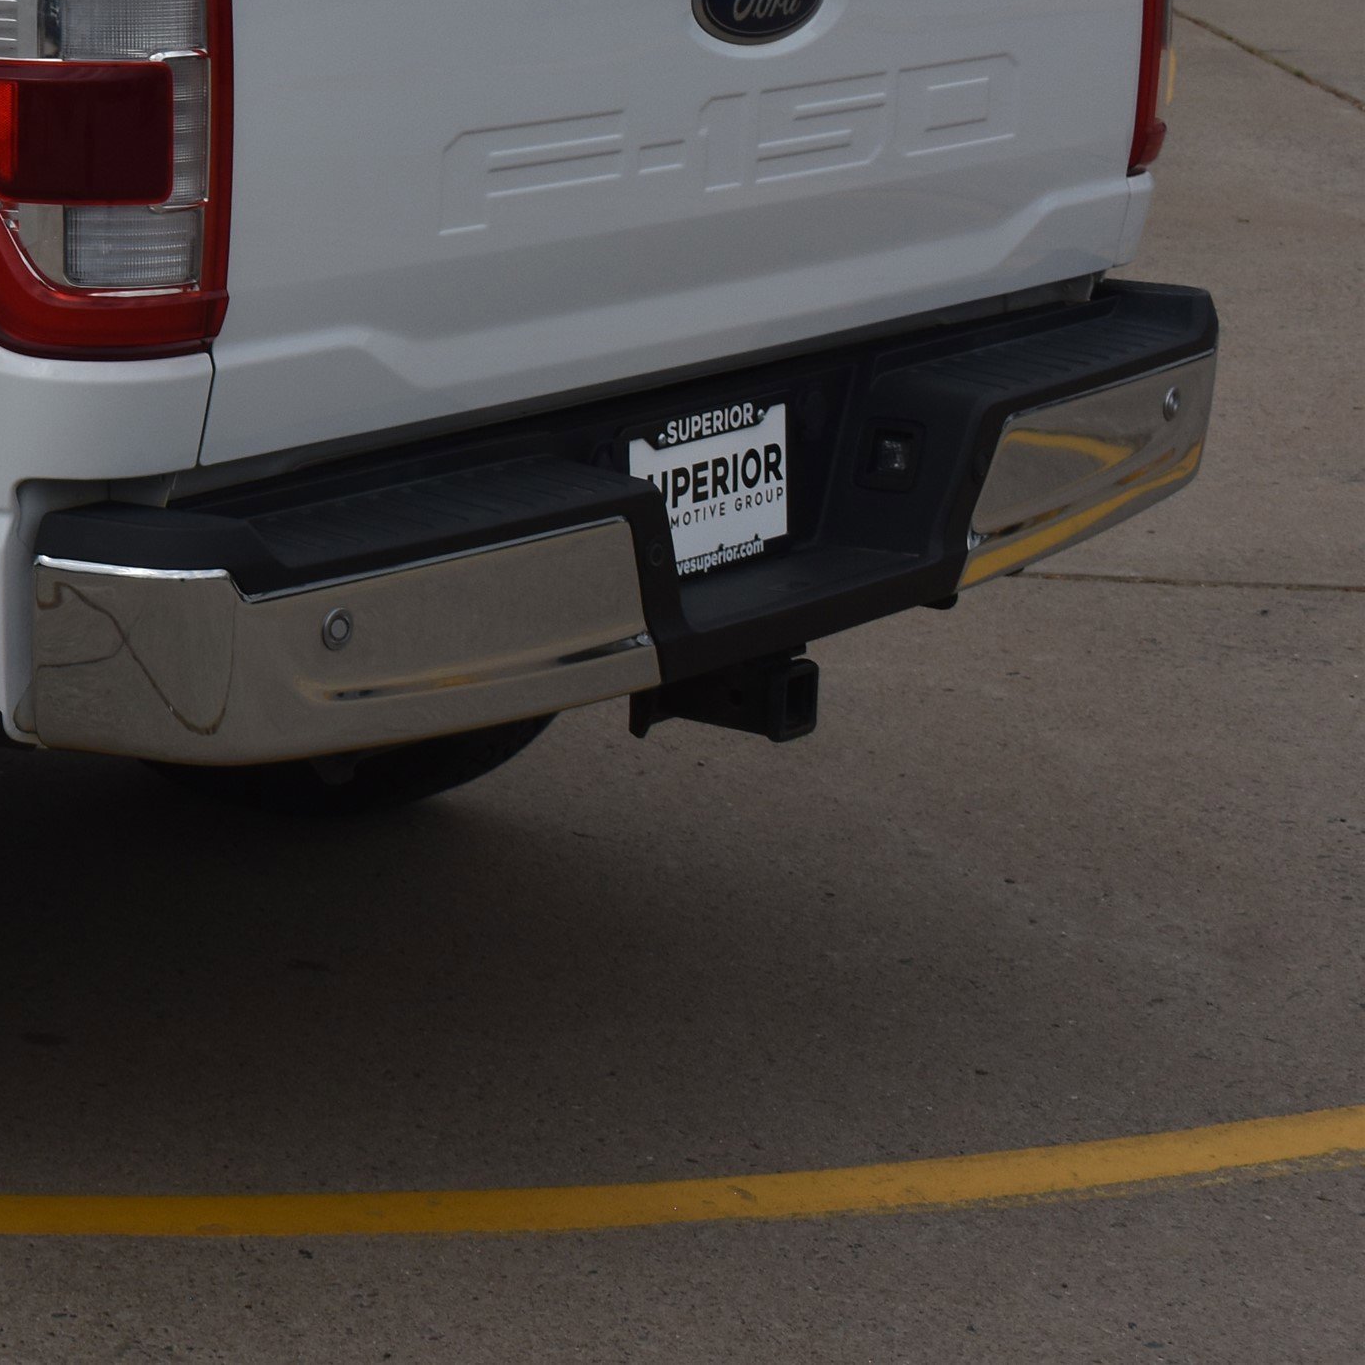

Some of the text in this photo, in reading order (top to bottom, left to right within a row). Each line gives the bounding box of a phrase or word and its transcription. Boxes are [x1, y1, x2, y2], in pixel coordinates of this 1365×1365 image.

[439, 52, 1020, 236] F-150
[666, 402, 754, 445] SUPERIOR
[647, 442, 783, 509] UPERIOR
[670, 486, 784, 530] MOTIVE GROUP
[676, 537, 764, 576] vesuperior.com
